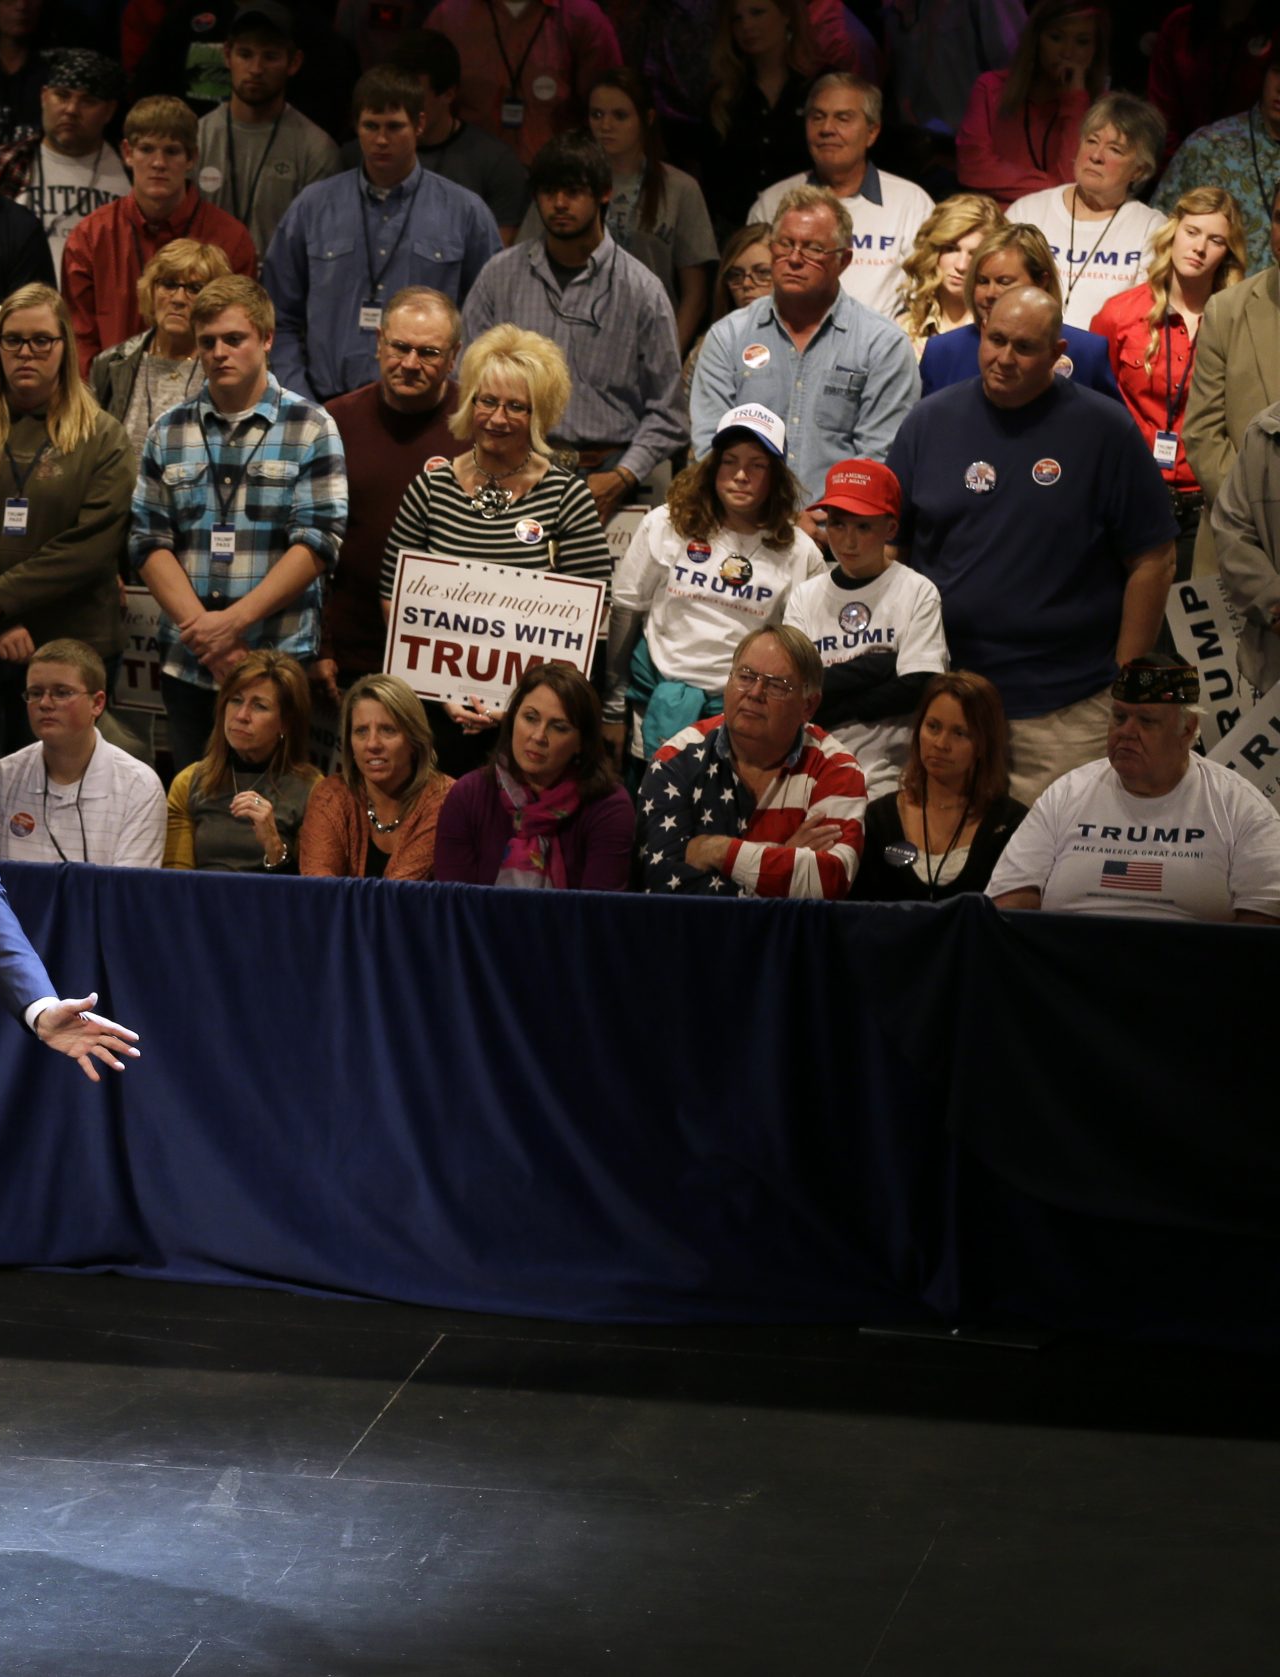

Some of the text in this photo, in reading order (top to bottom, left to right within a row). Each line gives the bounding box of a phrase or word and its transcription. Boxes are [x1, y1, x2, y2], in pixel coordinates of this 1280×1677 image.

[1048, 245, 1141, 266] RUMP
[734, 408, 775, 424] TRUMP
[674, 565, 773, 602] TRUMP
[406, 576, 589, 626] the silent majority
[403, 606, 584, 651] STANDS WITH
[1077, 823, 1206, 844] TRUMP
[1072, 844, 1204, 860] MAKE AMERICA GREAT AGAIN!
